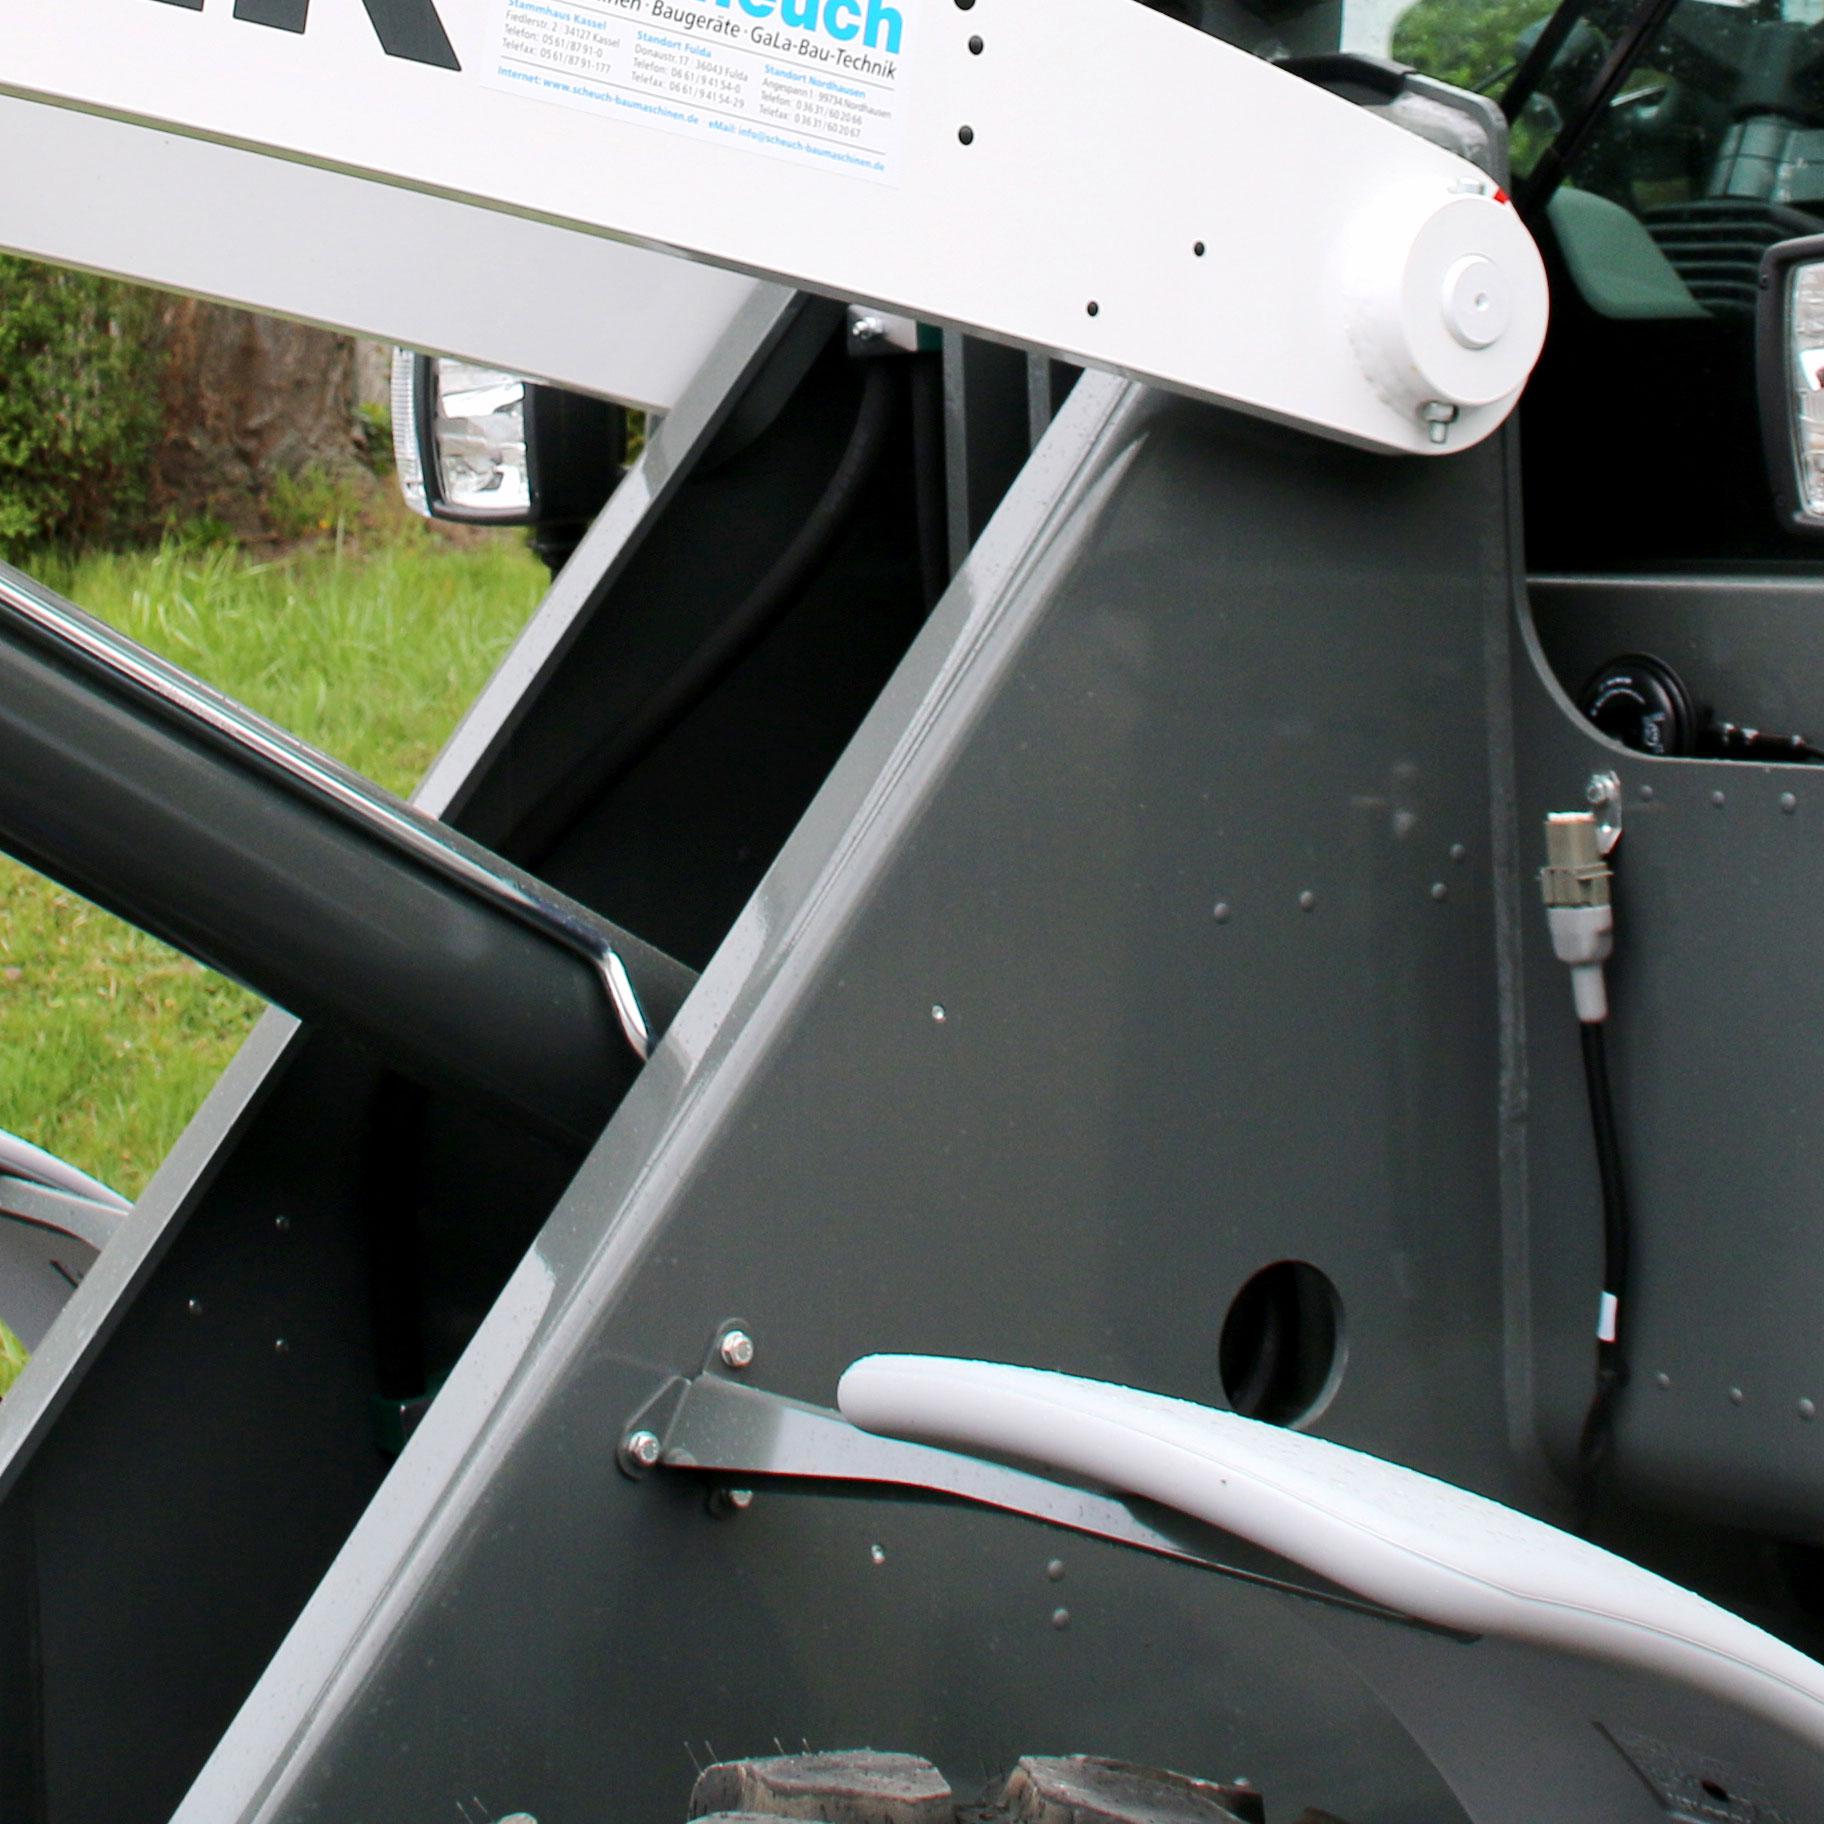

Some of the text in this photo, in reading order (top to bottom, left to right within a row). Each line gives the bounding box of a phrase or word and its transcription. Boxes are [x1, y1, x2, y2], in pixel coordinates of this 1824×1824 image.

[574, 14, 606, 30] Kassel
[565, 25, 591, 40] 34127
[593, 34, 620, 47] Kassel
[637, 31, 712, 58] Standort Fulda
[652, 0, 740, 38] Baugeräte
[751, 26, 896, 79] GaLa-Bau-Technik
[498, 66, 541, 84] Internet:
[696, 59, 722, 75] 36043
[725, 67, 748, 82] Fulda
[764, 64, 865, 98] Standort Nordhausen
